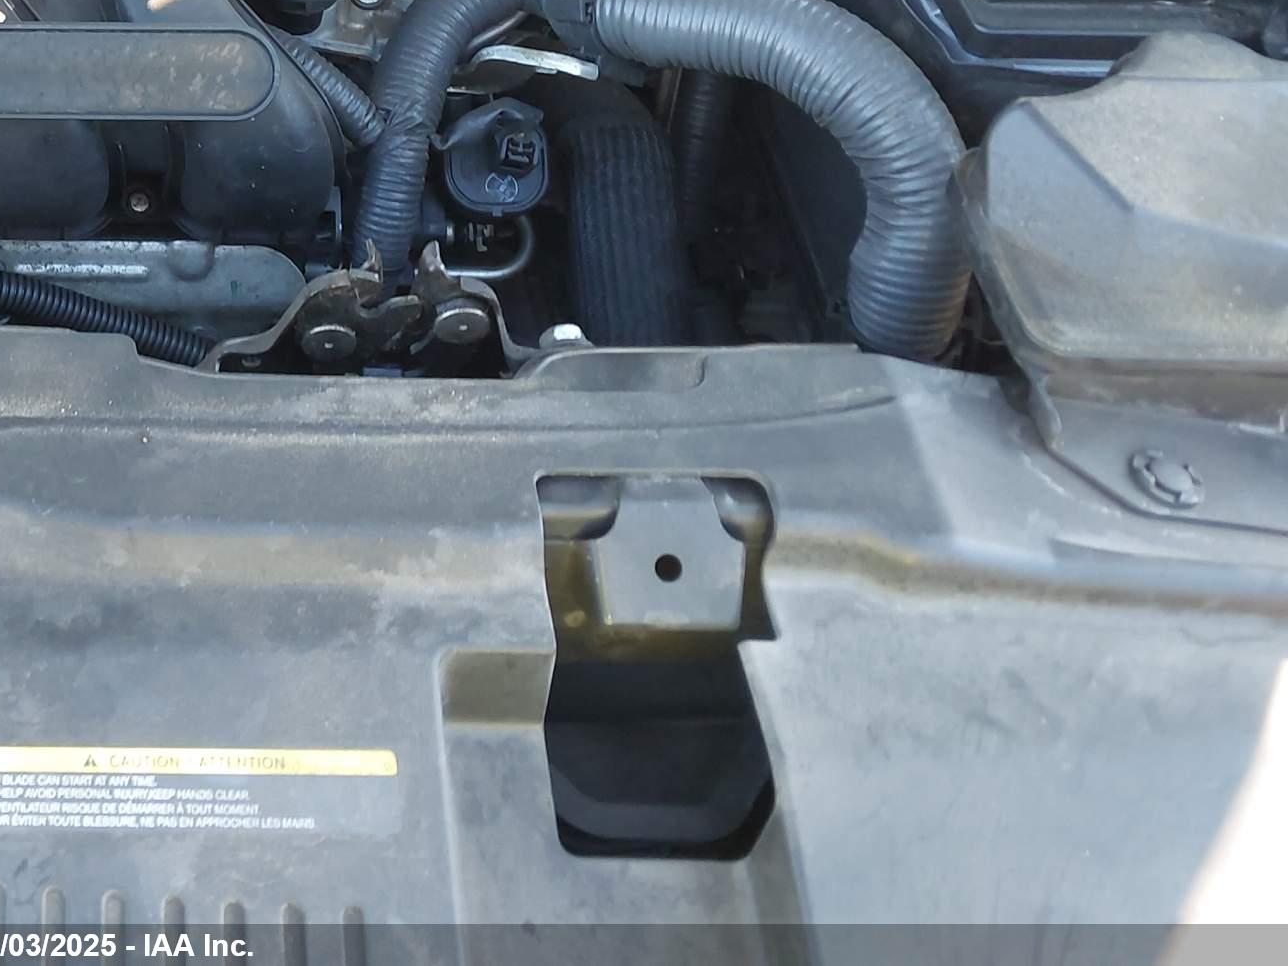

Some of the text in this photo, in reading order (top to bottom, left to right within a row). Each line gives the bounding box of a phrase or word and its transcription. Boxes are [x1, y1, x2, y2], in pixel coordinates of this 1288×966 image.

[109, 753, 286, 770] CAUTION ATTENTION
[2, 774, 35, 786] BLADE
[37, 774, 60, 786] CAN
[61, 774, 93, 786] START
[94, 775, 107, 786] AT
[108, 775, 130, 787] ANY
[130, 775, 158, 787] TIME.
[24, 787, 56, 799] AVOID
[57, 787, 112, 800] PERSONAL
[177, 789, 214, 801] HANDS
[62, 802, 100, 814] RISQUE
[101, 802, 117, 815] DE
[118, 800, 175, 815] DÉMARRER
[176, 801, 185, 815] À
[186, 803, 213, 816] TOUT
[11, 812, 47, 827] ÉVITER
[48, 815, 81, 827] TOUTE
[139, 815, 155, 828] NE
[156, 816, 177, 828] PAS
[178, 816, 194, 828] EN
[194, 816, 259, 829] APPROCHER
[260, 817, 281, 829] LES
